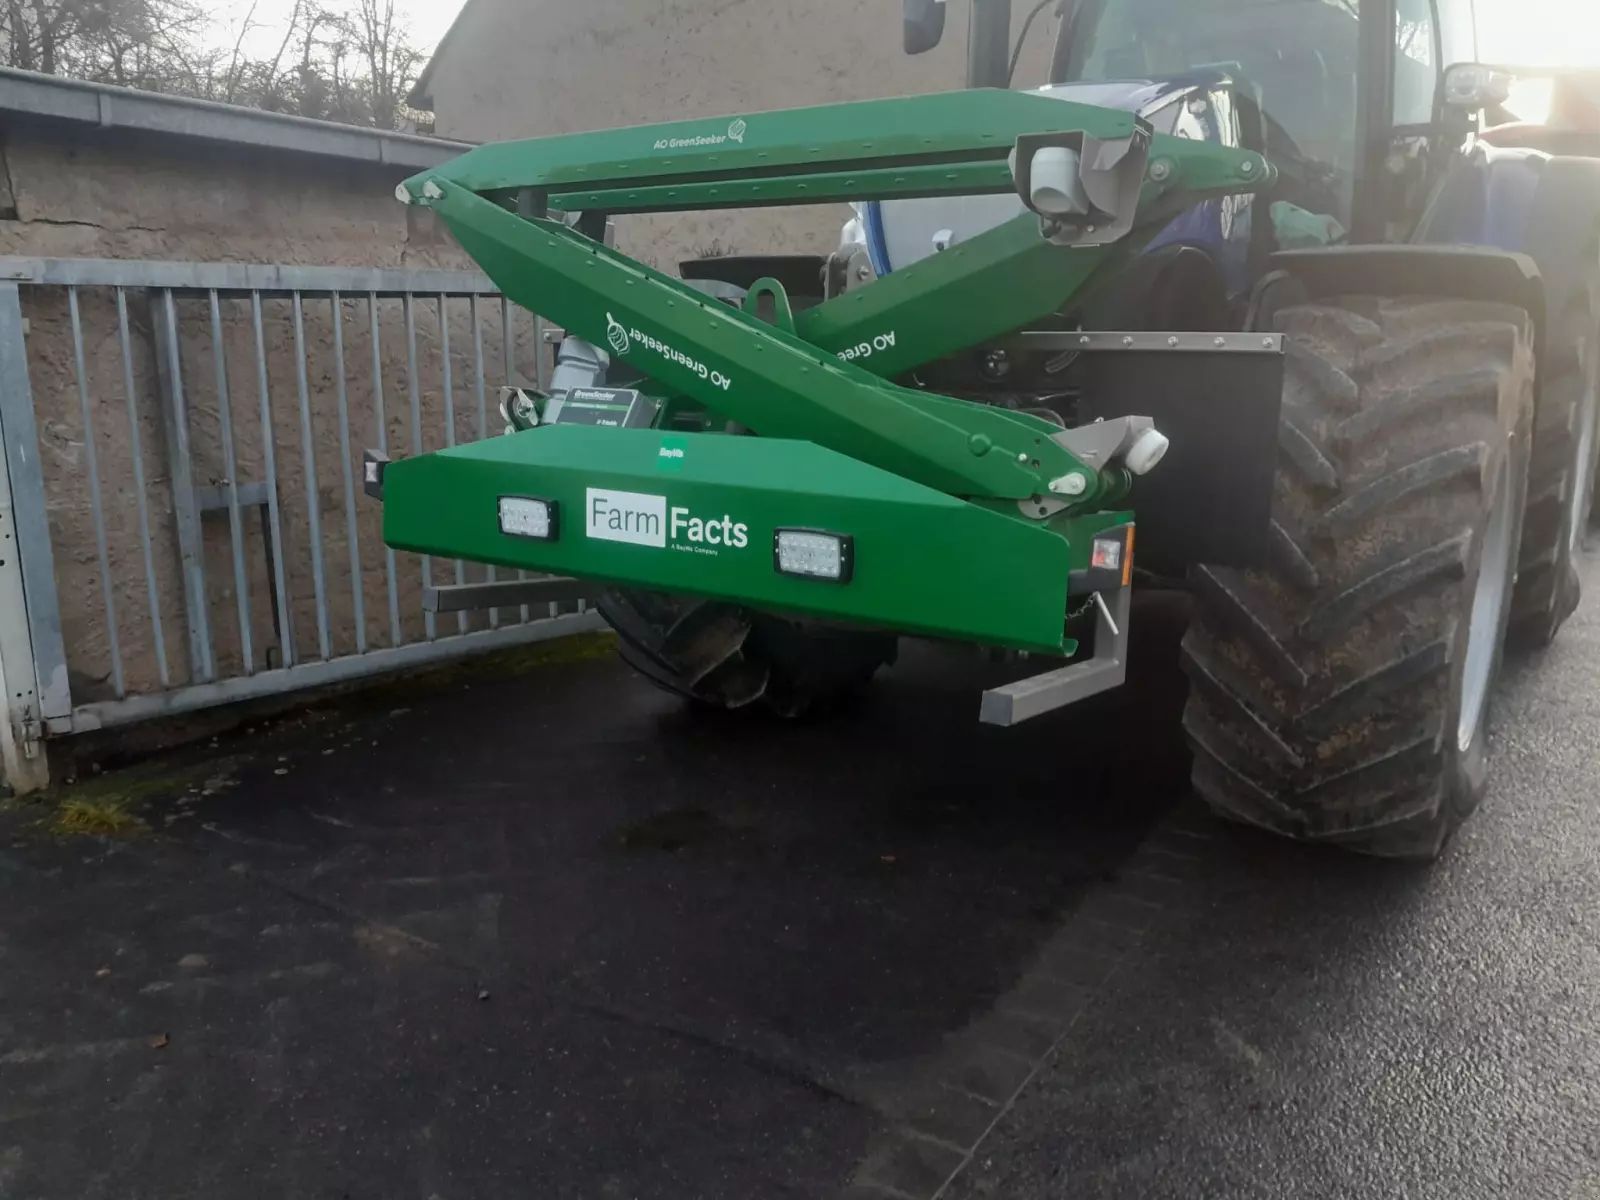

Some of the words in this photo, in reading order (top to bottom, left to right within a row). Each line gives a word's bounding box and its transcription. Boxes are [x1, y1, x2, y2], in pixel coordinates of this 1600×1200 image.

[653, 139, 669, 150] AO
[669, 134, 727, 148] GreenSeeker
[873, 330, 896, 350] AO
[628, 327, 708, 379] GreenSeeker
[710, 370, 731, 390] AO
[592, 497, 660, 535] Farm
[671, 506, 748, 548] Facts
[694, 546, 718, 556] Company
